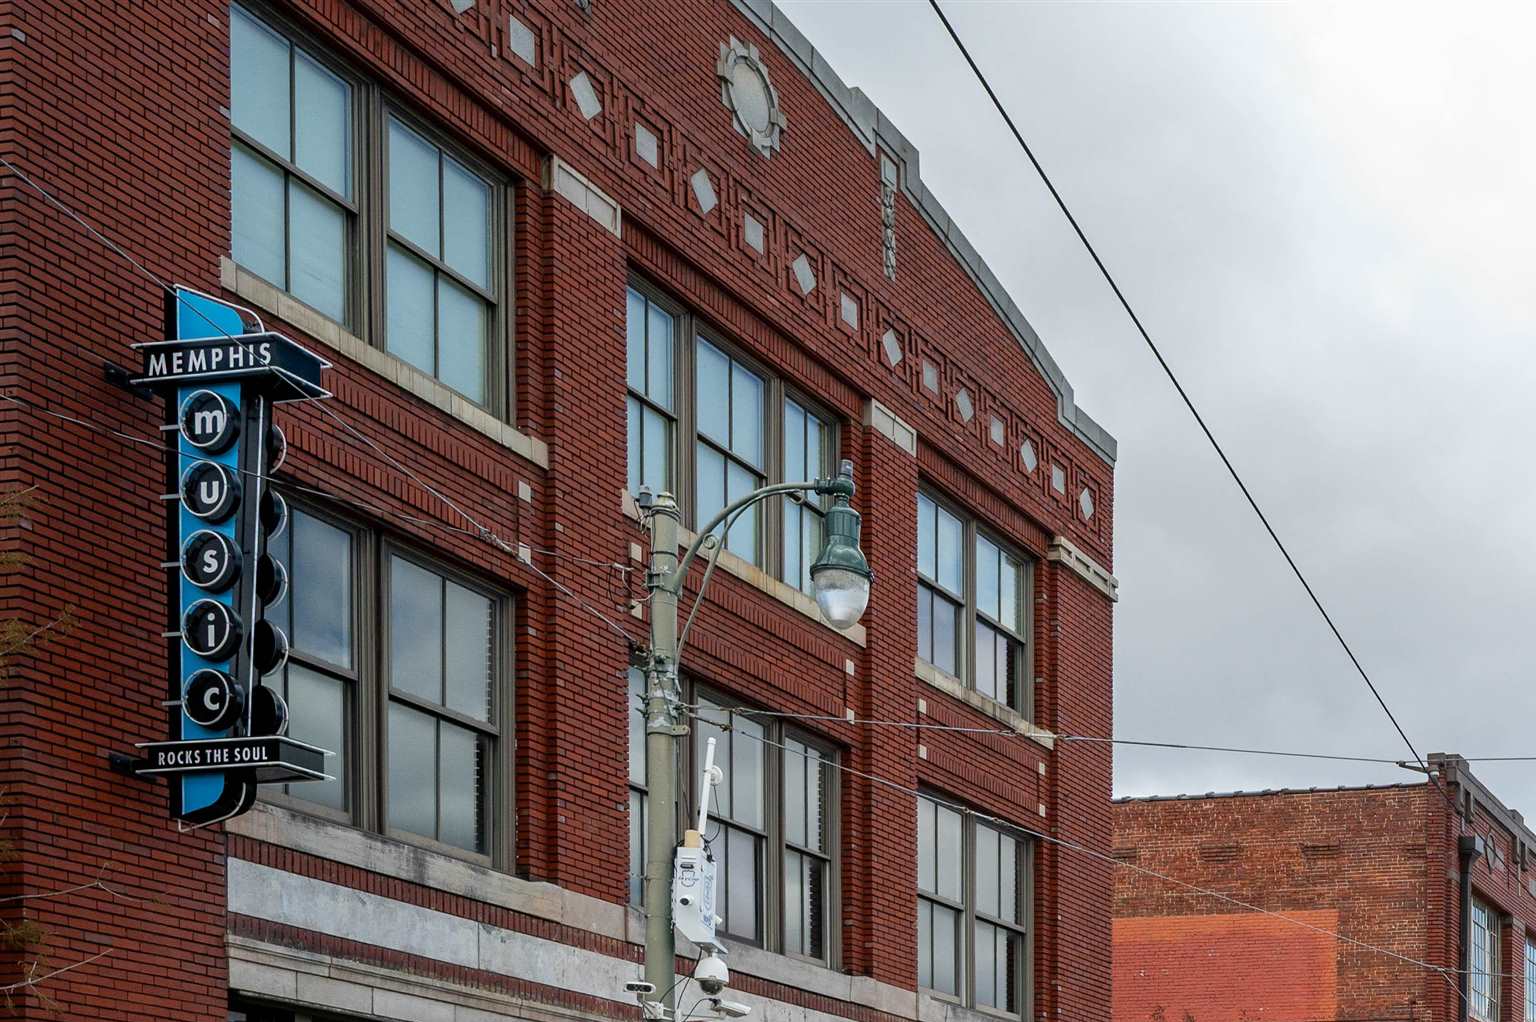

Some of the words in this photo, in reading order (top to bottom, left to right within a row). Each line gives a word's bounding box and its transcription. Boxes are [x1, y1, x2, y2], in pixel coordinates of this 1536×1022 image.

[148, 343, 272, 377] MEMPHIS
[194, 408, 223, 713] music
[158, 749, 201, 766] ROCKS
[205, 748, 229, 763] THE
[234, 746, 268, 762] SOUL
